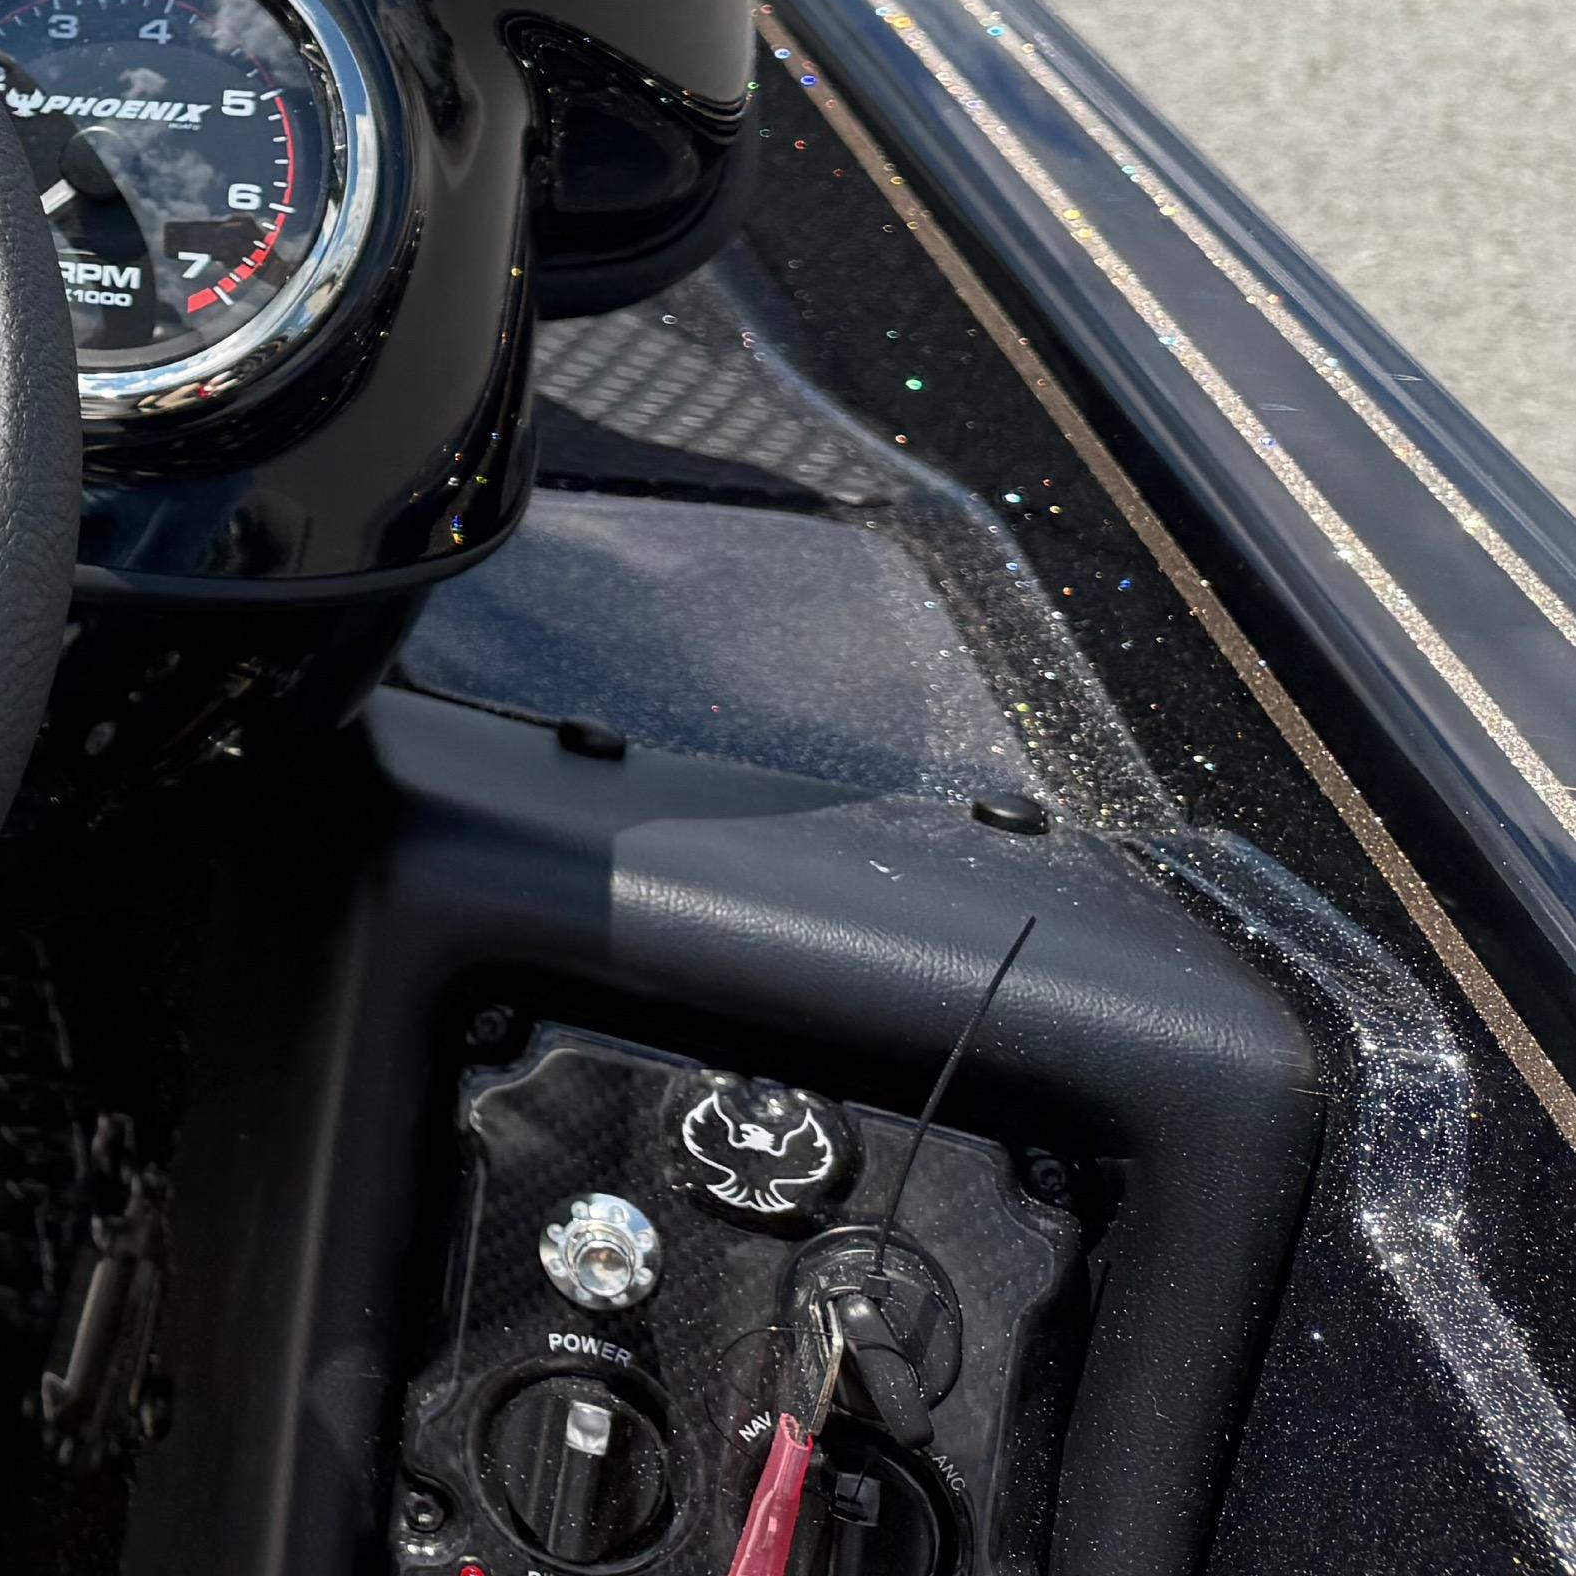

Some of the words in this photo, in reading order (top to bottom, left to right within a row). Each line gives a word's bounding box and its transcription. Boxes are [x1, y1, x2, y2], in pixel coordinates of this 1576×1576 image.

[48, 14, 78, 39] 3
[139, 19, 173, 45] 4
[41, 95, 211, 123] PHOENIX
[221, 90, 256, 116] 5
[228, 184, 262, 210] 6
[58, 261, 141, 289] RPM
[178, 252, 210, 278] 7
[548, 1333, 631, 1367] POWER
[739, 1411, 773, 1442] NAV
